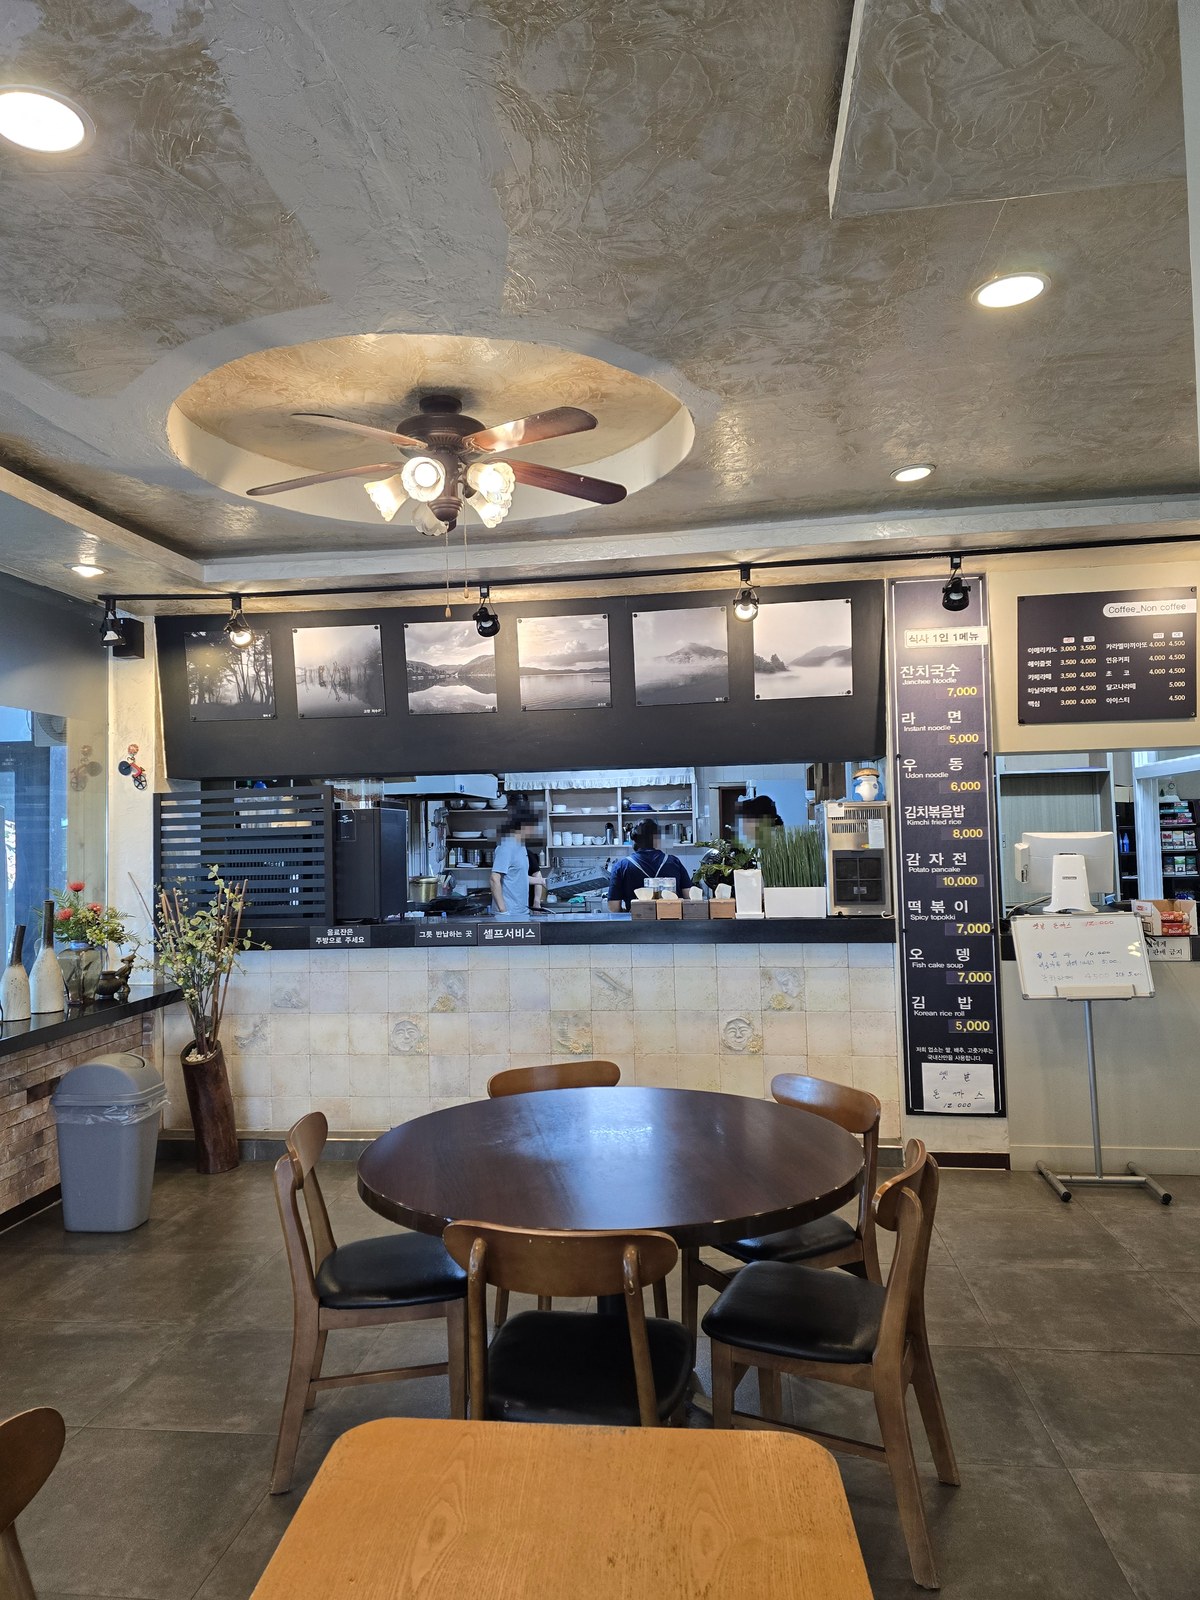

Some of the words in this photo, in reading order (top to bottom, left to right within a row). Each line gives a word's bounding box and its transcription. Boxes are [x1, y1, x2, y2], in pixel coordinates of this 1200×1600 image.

[909, 634, 929, 643] 식사
[933, 633, 948, 642] 1인
[953, 632, 979, 641] 1메뉴
[1028, 646, 1057, 654] 아메리카노
[900, 664, 961, 678] 잔치국수
[947, 687, 977, 697] 7,000
[949, 734, 979, 744] 5,000
[951, 782, 980, 792] 6,000
[904, 805, 965, 818] 김치볶음밥
[953, 829, 982, 839] 8,000
[465, 930, 472, 938] 곳
[484, 928, 535, 940] 셀프서비스
[956, 924, 990, 935] 7,000
[958, 972, 992, 984] 7,000
[956, 1021, 990, 1032] 5,000
